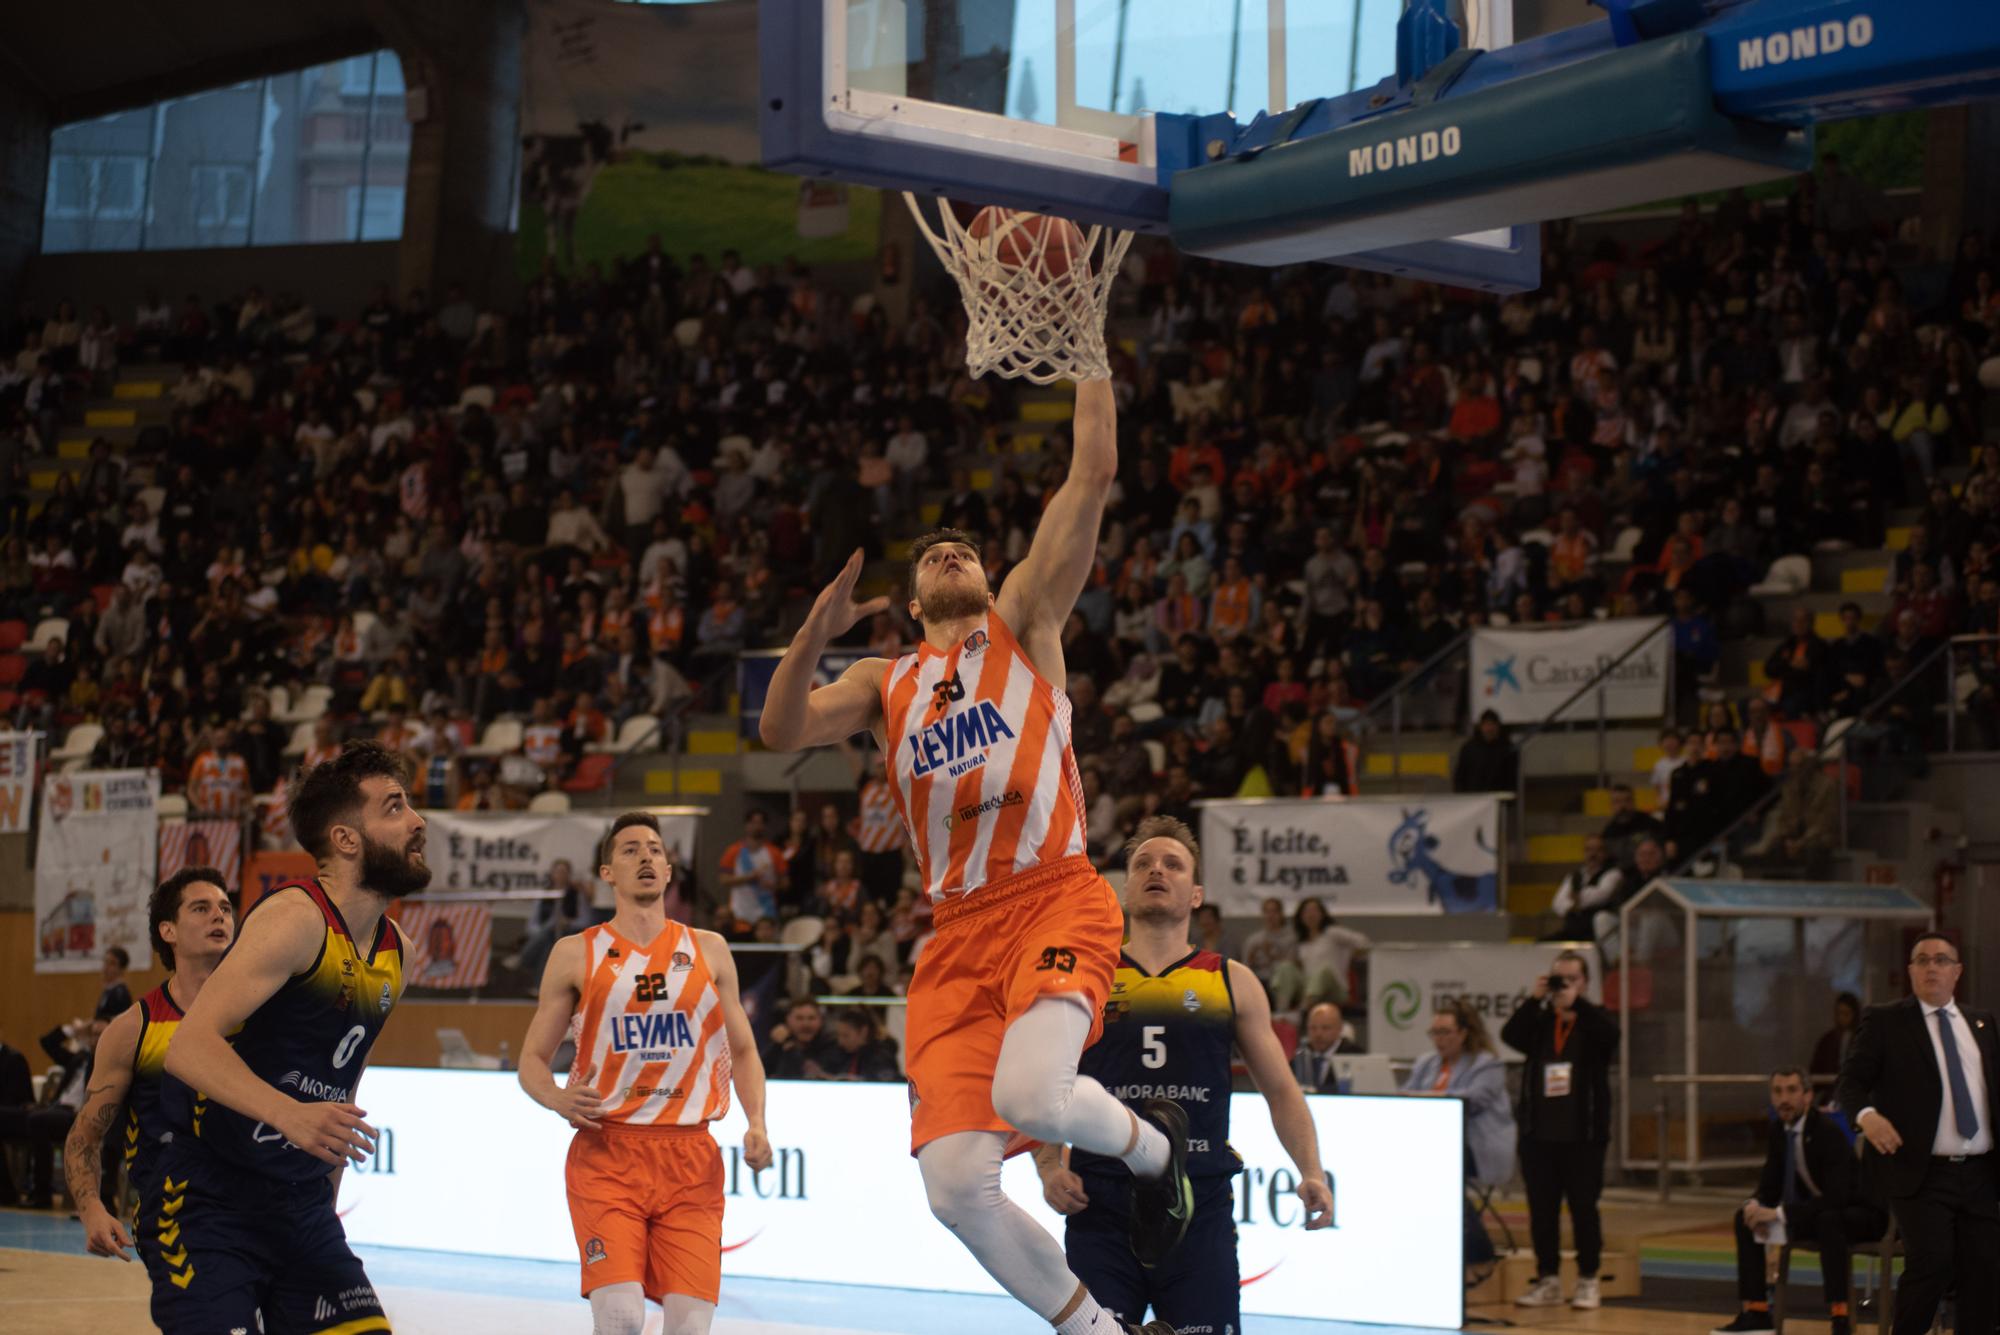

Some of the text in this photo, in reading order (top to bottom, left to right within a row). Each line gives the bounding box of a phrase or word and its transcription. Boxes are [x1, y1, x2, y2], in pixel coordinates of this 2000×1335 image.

[1738, 15, 1873, 71] MONDO
[1348, 126, 1462, 178] MONDO
[908, 701, 1016, 777] LEYMA
[948, 752, 987, 778] NATURA
[1231, 818, 1330, 857] É leite,
[470, 863, 555, 892] Leyma
[1258, 858, 1349, 892] Leyma
[635, 972, 669, 1002] 22
[332, 1024, 366, 1069] 0
[611, 1012, 695, 1051] LEYMA
[1141, 1026, 1167, 1069] 5
[640, 1051, 672, 1062] NATURA
[1114, 1084, 1211, 1102] MORABANC
[718, 1145, 809, 1201] ren
